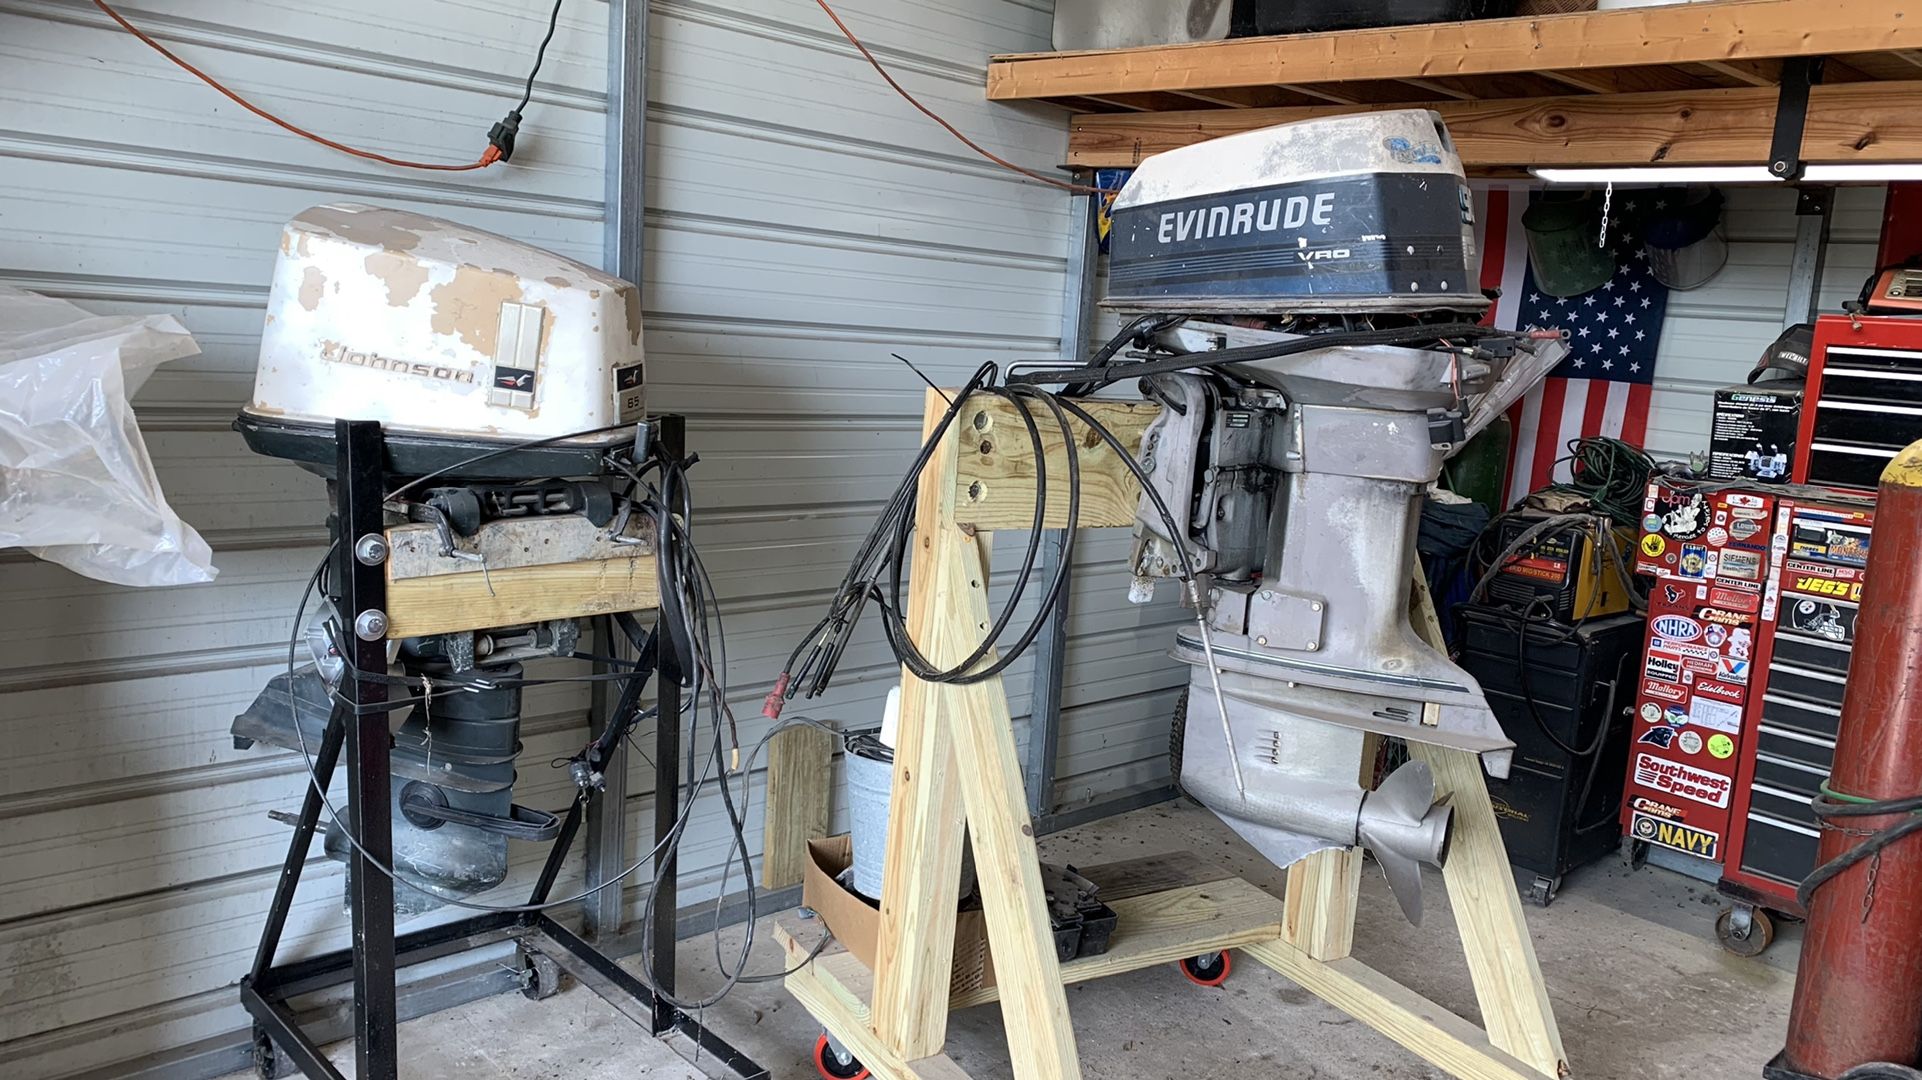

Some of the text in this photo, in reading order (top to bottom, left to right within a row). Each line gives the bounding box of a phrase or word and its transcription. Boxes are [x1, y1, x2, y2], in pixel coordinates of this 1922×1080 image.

[1158, 192, 1335, 243] EVINRUDE
[1298, 249, 1350, 262] VRO
[320, 344, 474, 384] Johnson
[628, 396, 640, 409] 65
[1723, 553, 1757, 565] SIEMENS
[1787, 562, 1816, 572] CENTER
[1717, 577, 1760, 589] CENTER LINE
[1796, 577, 1850, 596] JEG'S
[1699, 607, 1750, 623] CRANE
[1659, 619, 1695, 637] NHRA
[1663, 640, 1708, 651] PERFORMANCE
[1648, 656, 1679, 674] Holley
[1647, 681, 1685, 697] Mallory
[1697, 681, 1740, 699] Edelbrock
[1638, 755, 1730, 792] Southwest
[1656, 774, 1722, 803] Speed
[1658, 822, 1713, 854] NAVY
